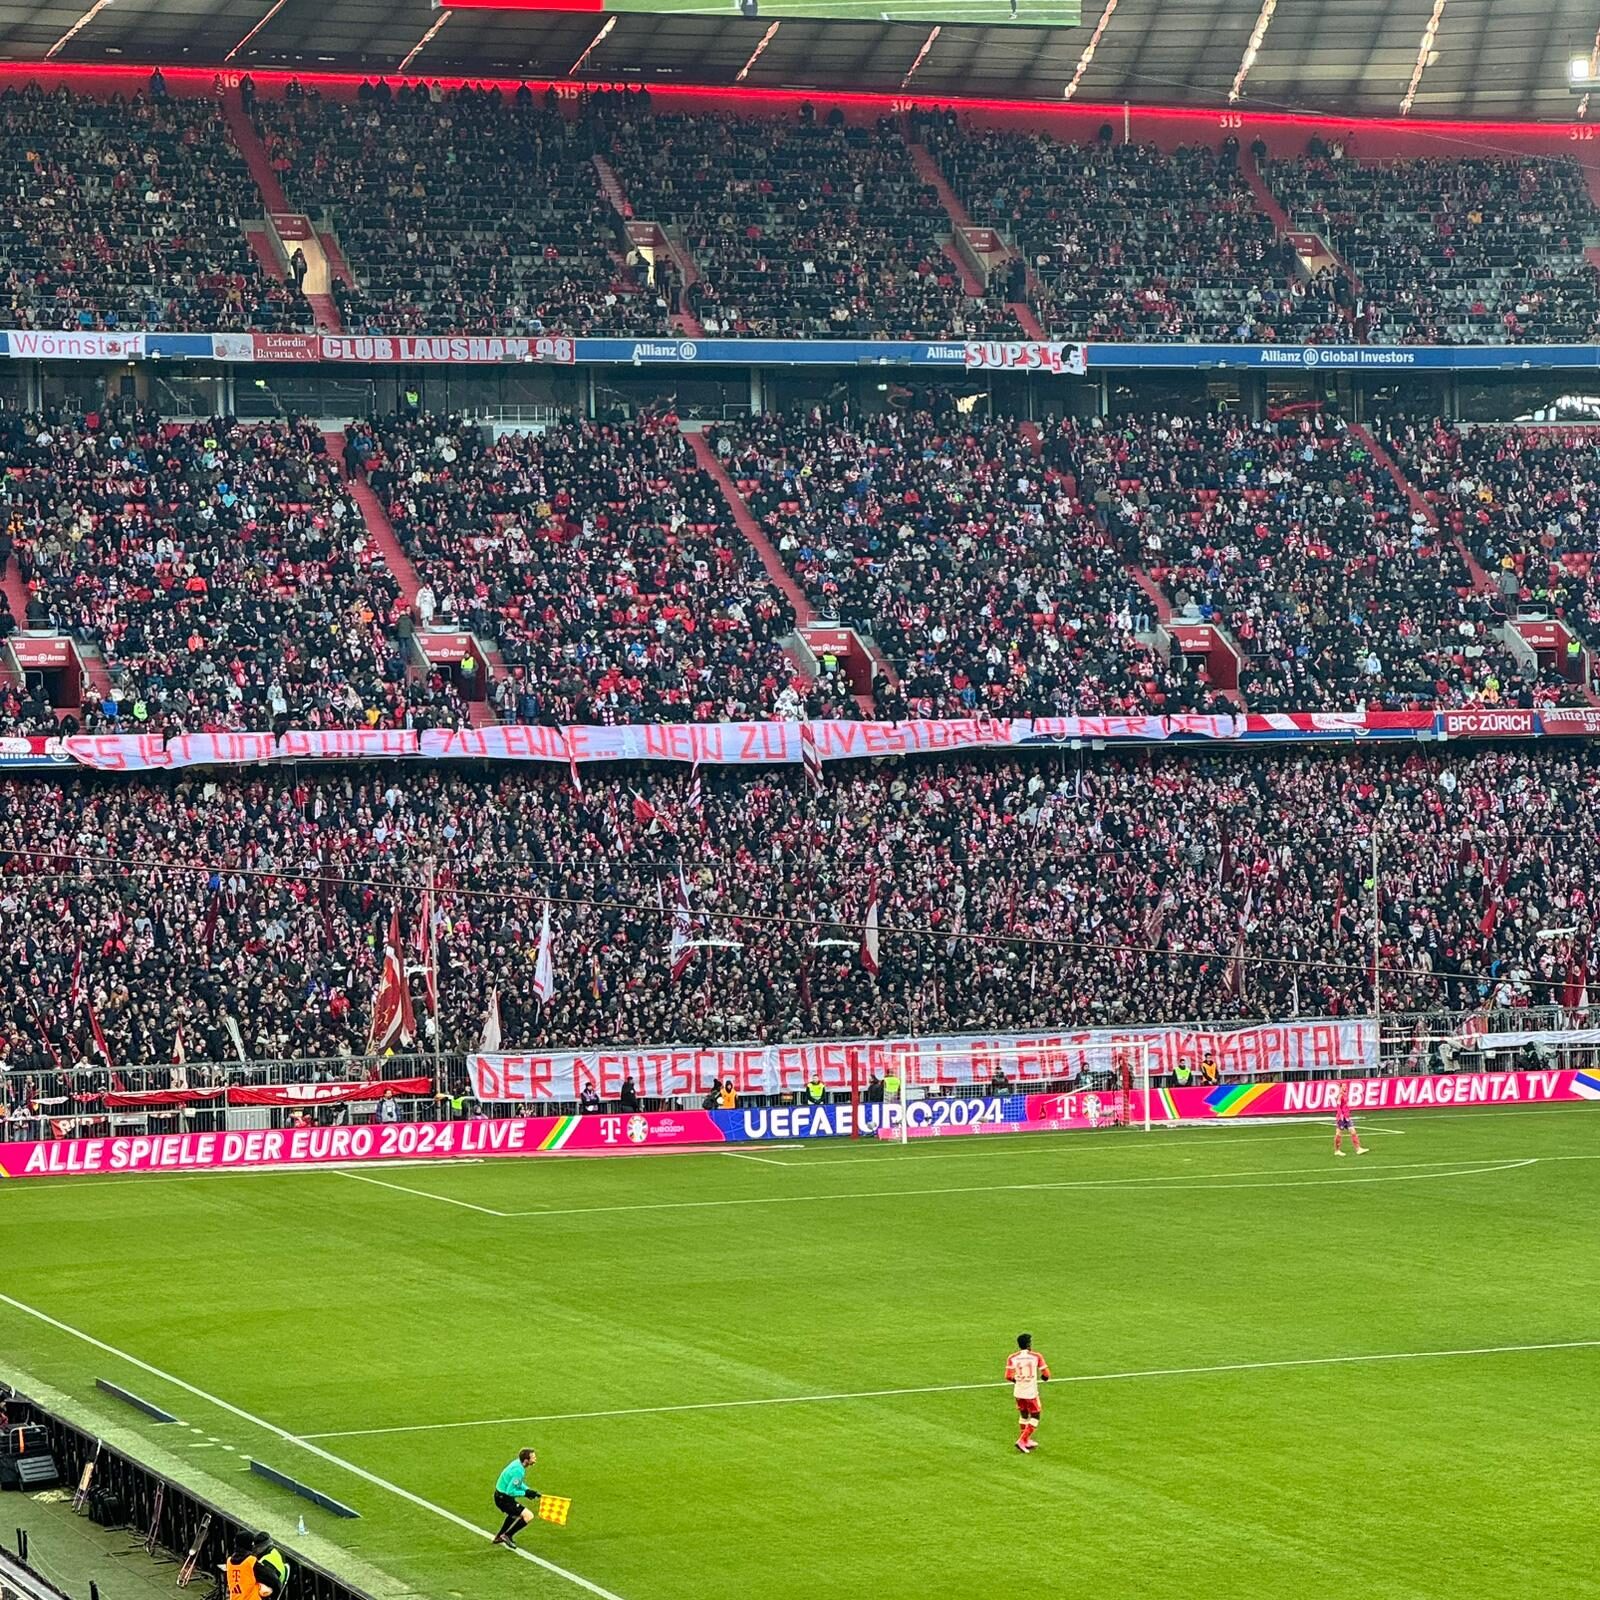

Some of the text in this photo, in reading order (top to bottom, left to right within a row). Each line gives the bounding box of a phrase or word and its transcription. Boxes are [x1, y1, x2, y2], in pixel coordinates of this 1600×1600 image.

[1220, 114, 1241, 128] 313
[1570, 127, 1593, 140] 312
[266, 337, 306, 347] Erfordia
[322, 338, 393, 360] CLUB
[634, 343, 677, 356] Allianz
[256, 349, 293, 358] Bavaria
[966, 343, 1042, 368] SUPS
[1261, 350, 1414, 363] Allianz Global Investors
[1448, 714, 1531, 731] BFC ZÜRICH
[645, 724, 723, 760] NEIN
[738, 724, 788, 759] ZU
[476, 1056, 553, 1099] DER
[572, 1050, 763, 1099] DEUTSCHE
[1283, 1071, 1559, 1111] NUR BEI MAGENTA TV
[744, 1105, 834, 1138] UEFA
[24, 1119, 527, 1173] ALLE SPIELE DER EURO 2024 LIVE
